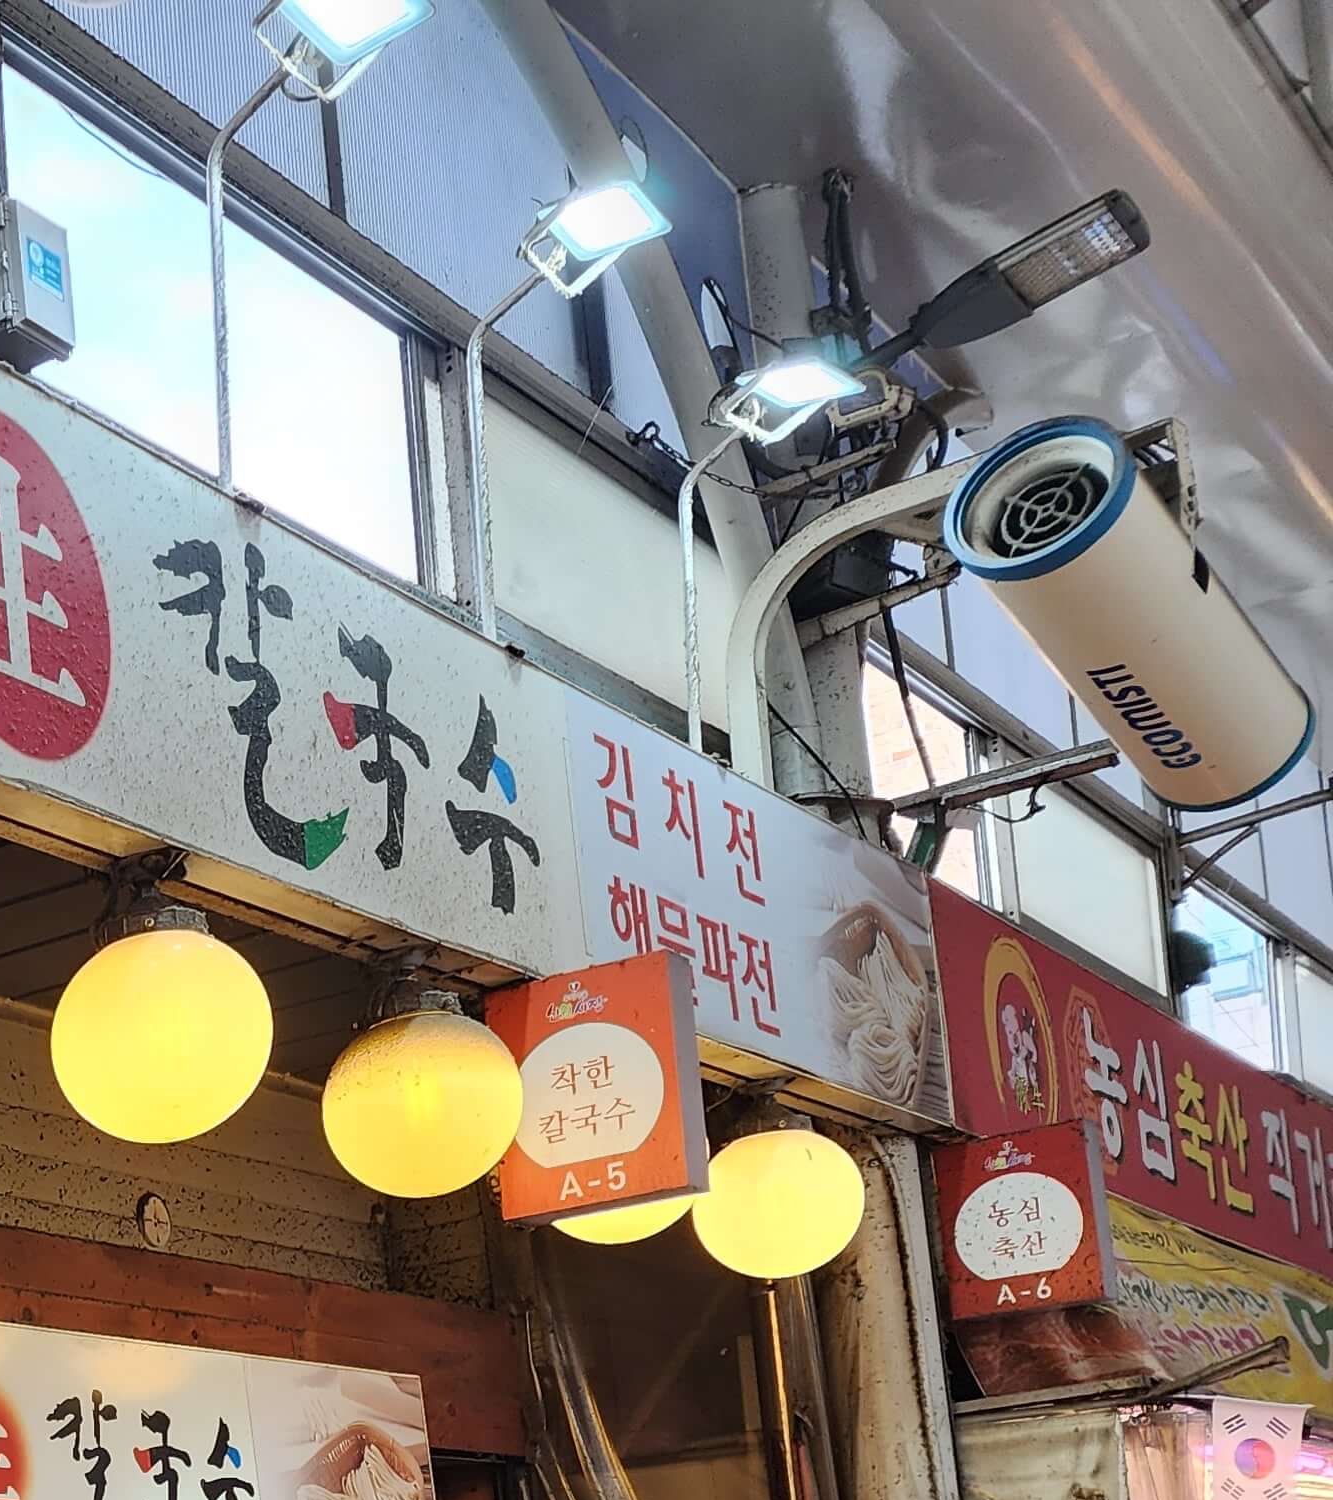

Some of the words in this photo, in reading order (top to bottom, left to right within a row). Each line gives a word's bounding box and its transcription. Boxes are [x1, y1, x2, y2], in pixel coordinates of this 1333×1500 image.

[153, 538, 540, 915] 칼국수
[593, 733, 767, 908] 김치전
[550, 1055, 616, 1096] 착한
[539, 1097, 637, 1145] 칼국수
[559, 1160, 627, 1200] A-5
[1260, 1107, 1333, 1252] 직거
[988, 1196, 1042, 1228] 농심
[991, 1230, 1048, 1260] 축산
[996, 1276, 1052, 1306] A-6
